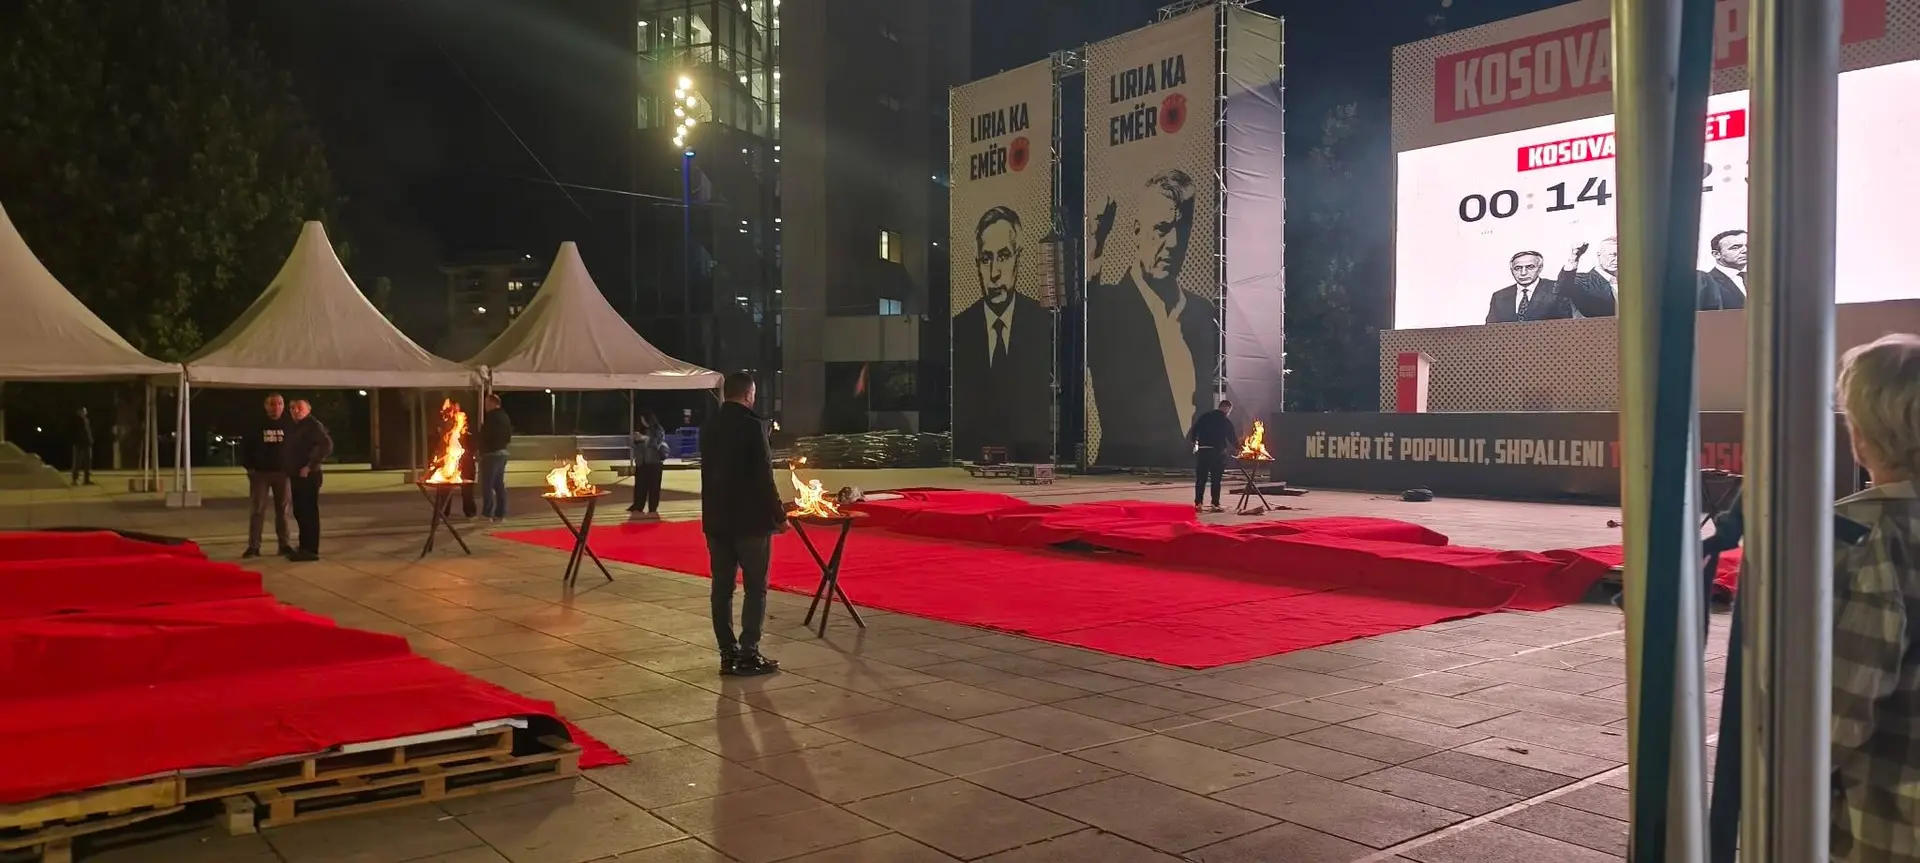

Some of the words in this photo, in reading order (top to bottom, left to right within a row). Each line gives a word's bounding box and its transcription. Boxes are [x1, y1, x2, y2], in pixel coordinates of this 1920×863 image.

[1110, 63, 1156, 104] LIRIA
[1161, 54, 1187, 88] KA
[1454, 27, 1613, 111] KOSOVA
[970, 108, 1007, 143] LIRIA
[1009, 102, 1030, 133] KA
[1110, 102, 1157, 146] EMËR
[970, 143, 1007, 181] EMËR
[1528, 136, 1616, 168] KOSOVA
[1546, 176, 1612, 212] 14
[1306, 431, 1326, 458] NË
[1328, 431, 1371, 460] EMËR
[1374, 431, 1394, 460] TË
[1400, 437, 1490, 466] POPULLIT,
[1495, 438, 1604, 467] SHPALLENI
